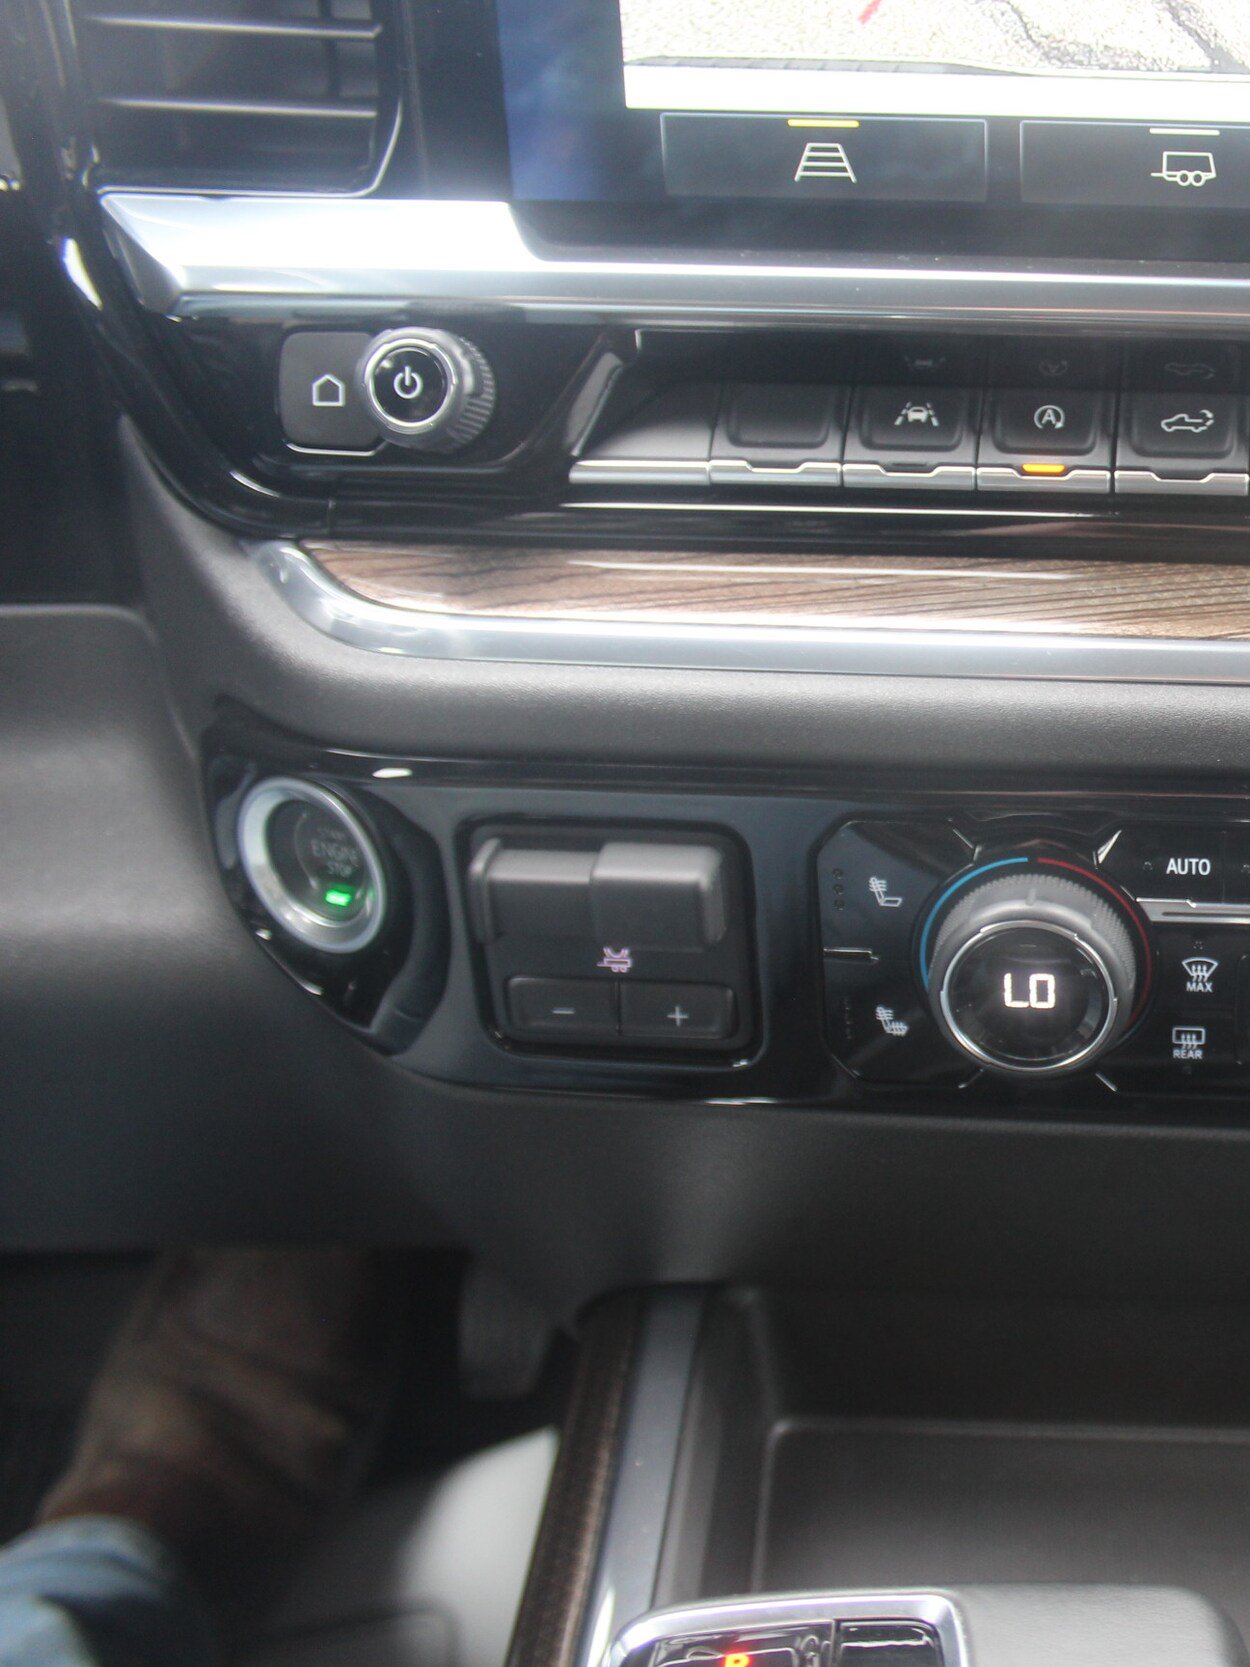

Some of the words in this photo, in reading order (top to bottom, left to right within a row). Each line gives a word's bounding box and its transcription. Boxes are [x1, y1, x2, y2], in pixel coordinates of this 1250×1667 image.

[1165, 857, 1211, 876] AUTO
[1003, 972, 1056, 1009] LO
[1185, 981, 1214, 993] MAX
[1172, 1049, 1204, 1060] REAR
